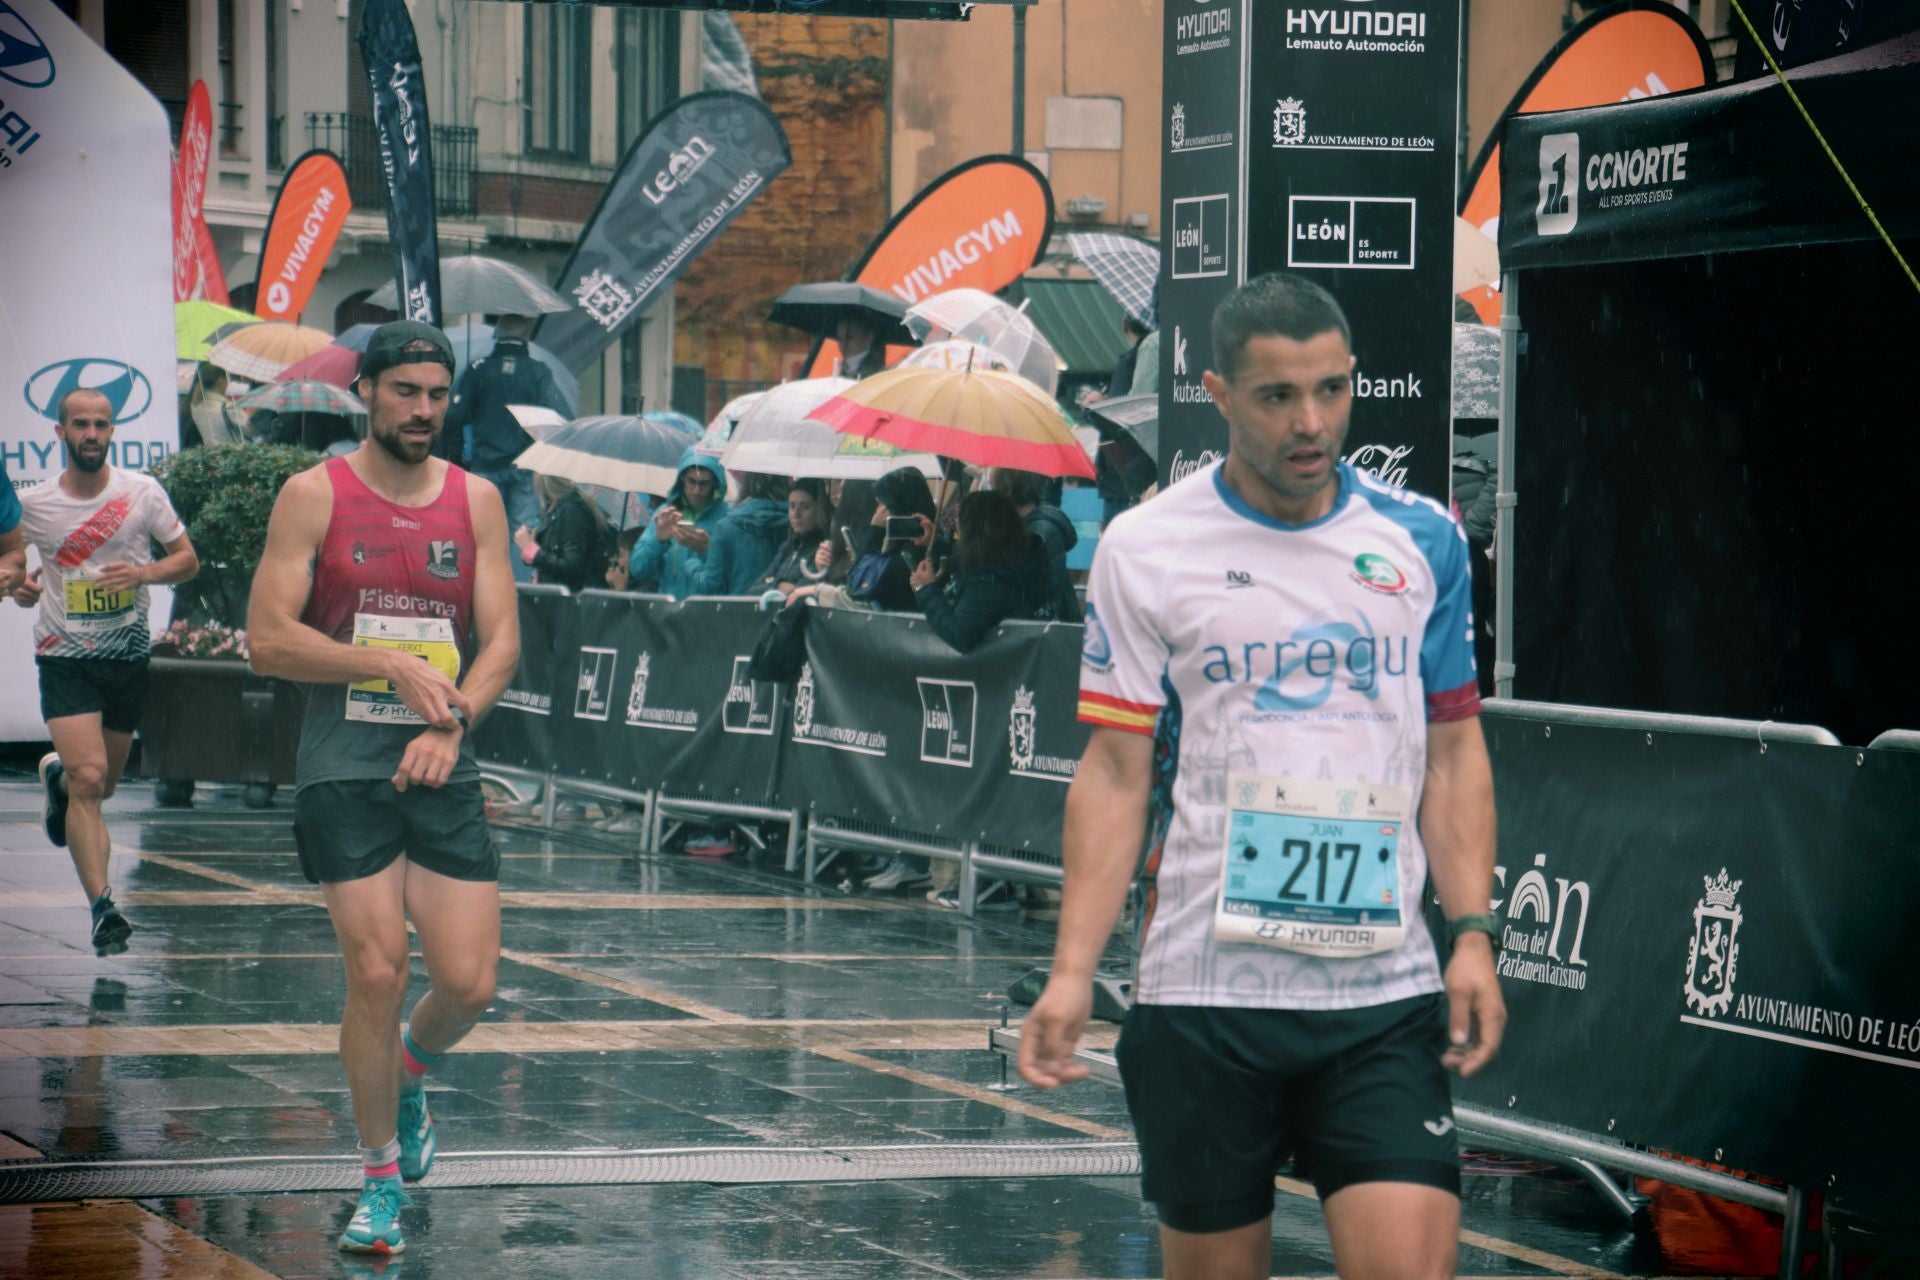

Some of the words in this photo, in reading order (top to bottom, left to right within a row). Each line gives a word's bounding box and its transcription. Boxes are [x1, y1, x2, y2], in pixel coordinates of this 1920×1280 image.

[1177, 8, 1231, 40] HYUNDAI
[1286, 9, 1426, 37] HYUNDAI
[1286, 37, 1343, 51] Lemauto
[1345, 39, 1425, 53] Automoción
[1308, 136, 1388, 146] AYUNTAMIENTO
[1391, 137, 1405, 147] DE
[1407, 136, 1434, 148] LEÓN
[1585, 142, 1689, 192] CCNORTE
[1599, 196, 1610, 208] ALL
[1611, 195, 1622, 206] FOR
[1624, 192, 1648, 206] SPORTS
[1649, 189, 1674, 203] EVENTS
[281, 187, 335, 282] VIVAGYM
[633, 218, 714, 296] AYUNTAMIENTO
[713, 201, 730, 219] DE
[727, 170, 759, 203] LEÓN
[1176, 222, 1199, 248] LEÓN
[1296, 218, 1346, 241] LEÓN
[892, 210, 1022, 304] VIVAGYM
[1358, 250, 1399, 259] DEPORTE
[1359, 240, 1370, 248] ES
[1173, 379, 1216, 403] kutxaba
[1349, 372, 1422, 398] bank
[358, 588, 457, 617] Fisiorama
[856, 729, 868, 746] DE
[868, 731, 887, 748] LEÓN
[1033, 755, 1080, 774] AYUNTAMIEN
[1309, 823, 1343, 837] JUAN
[1278, 838, 1361, 904] 217
[1291, 926, 1375, 945] HYUNDAI
[1502, 924, 1528, 953] Cuna
[1530, 929, 1549, 956] del
[1496, 951, 1586, 990] Parlamentarismo
[1736, 994, 1853, 1040] AYUNTAMIENTO
[1858, 1016, 1884, 1046] DE
